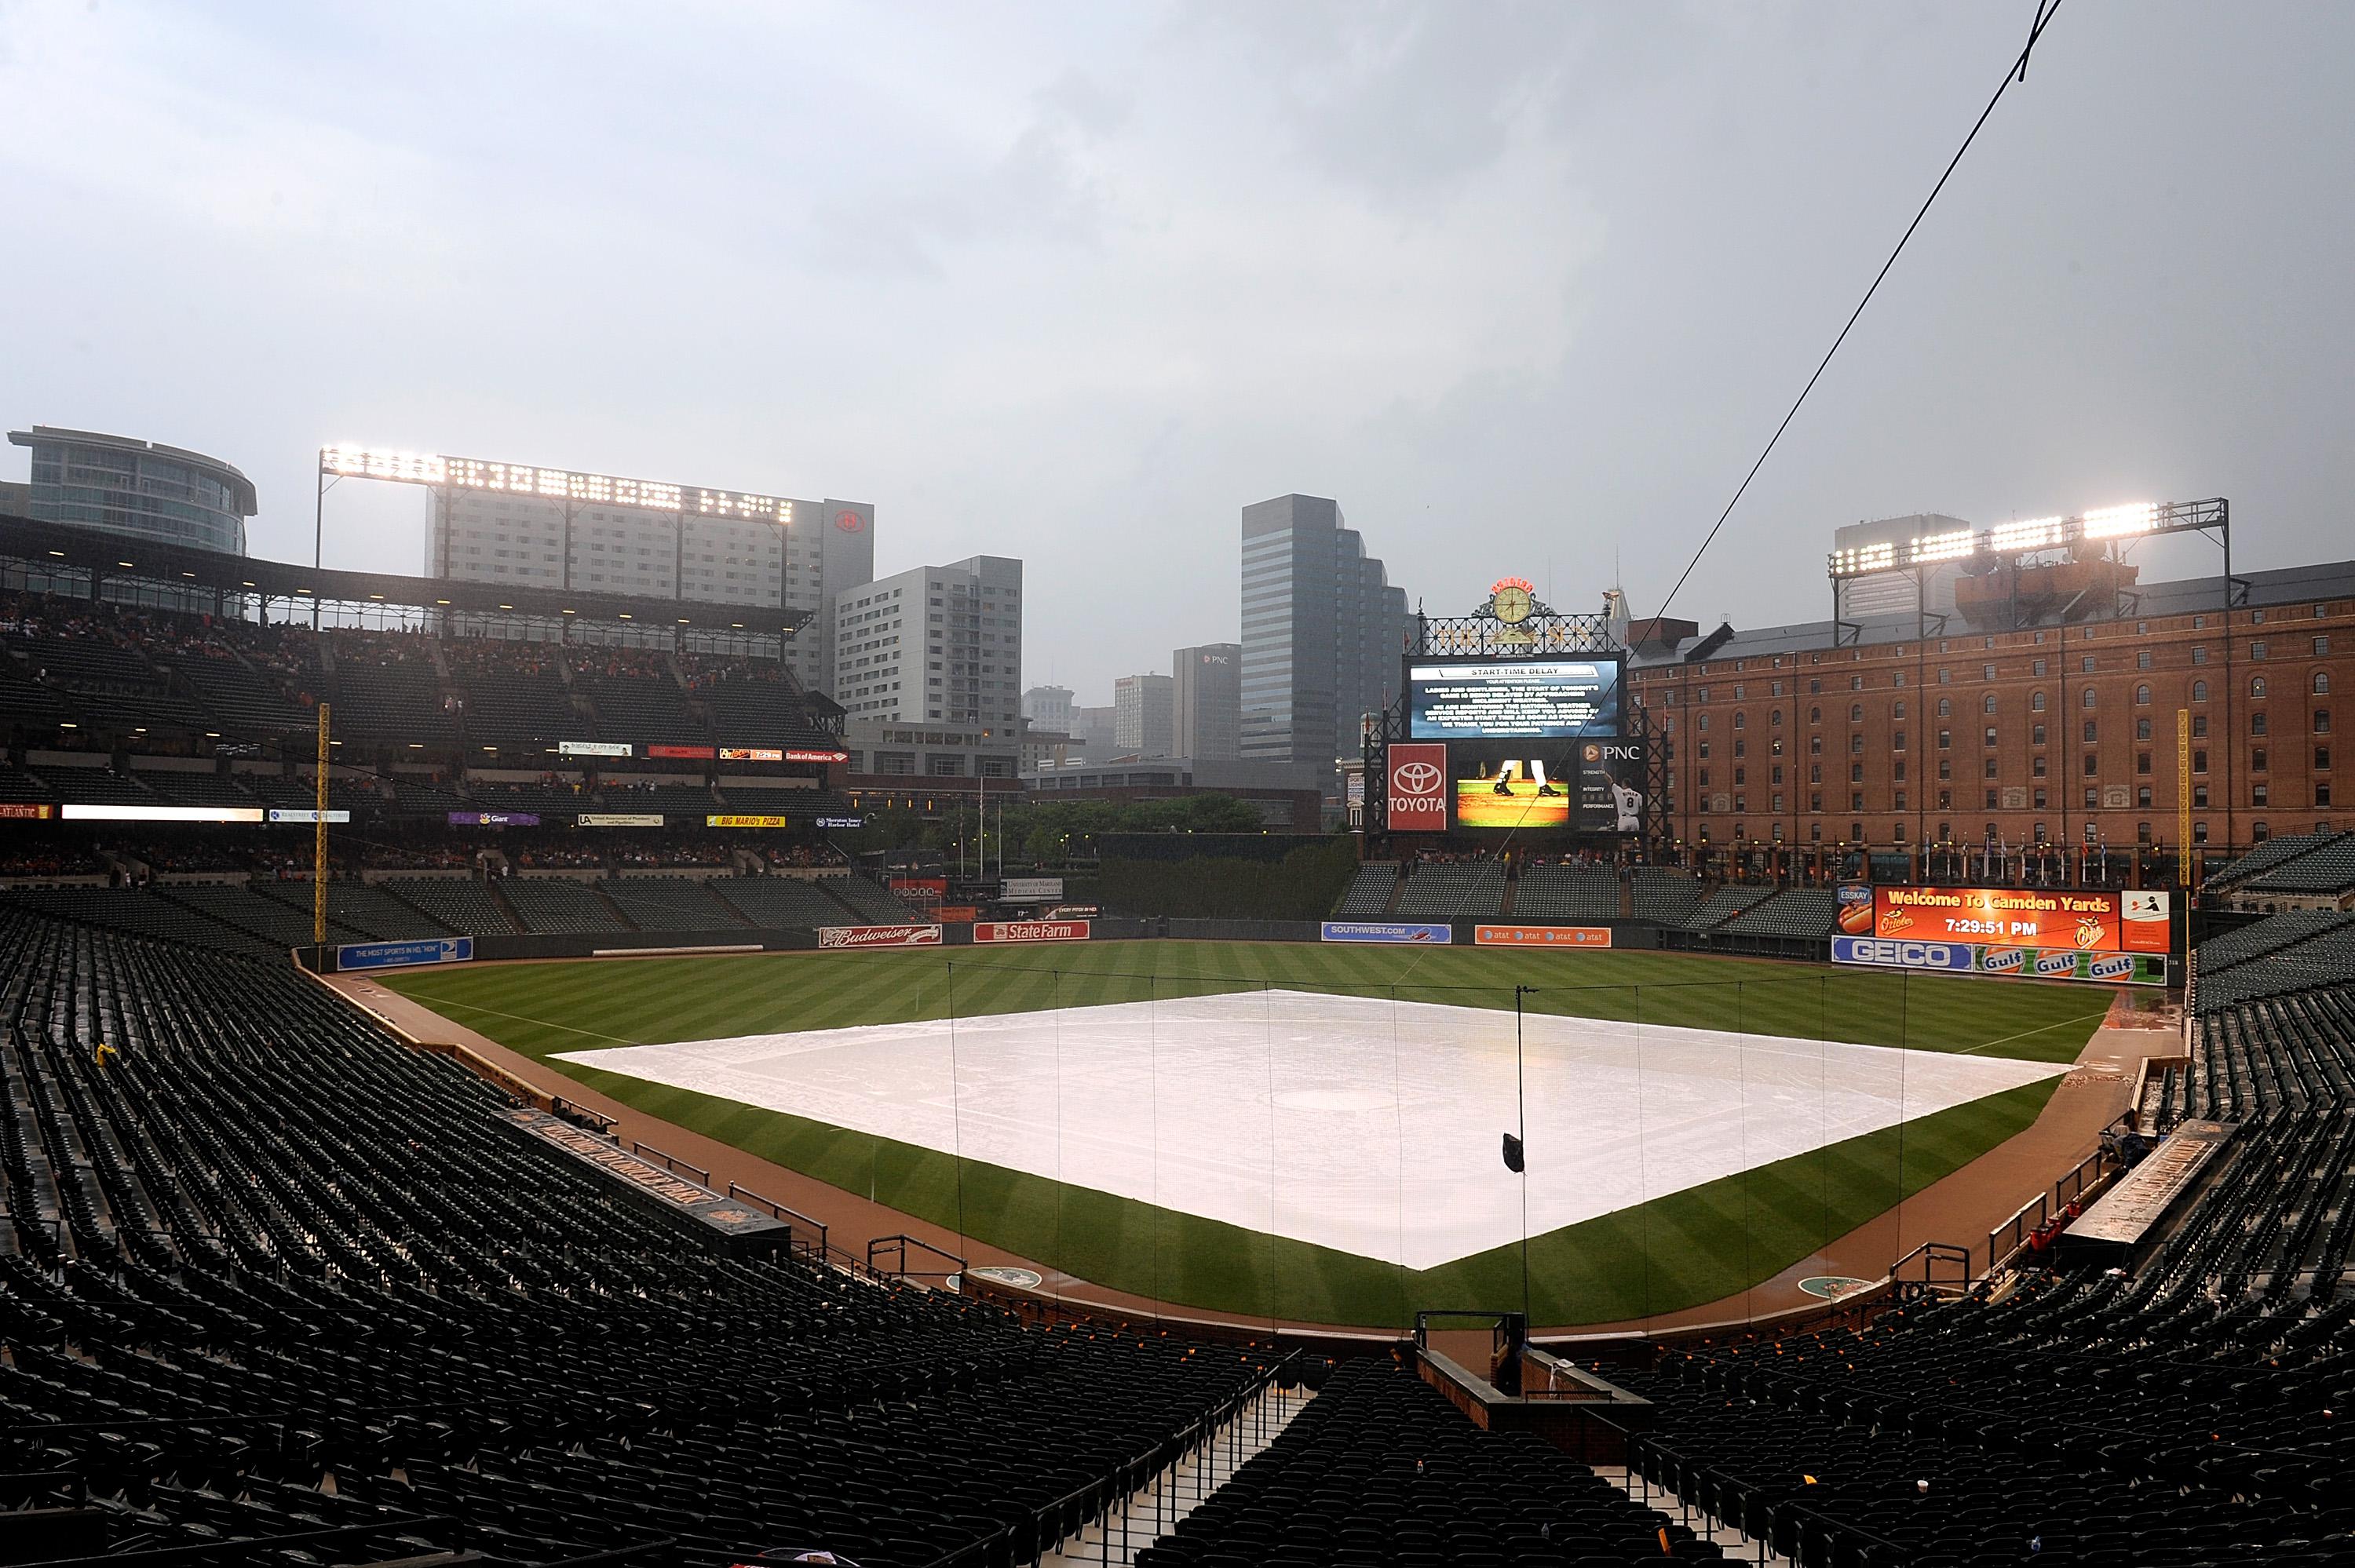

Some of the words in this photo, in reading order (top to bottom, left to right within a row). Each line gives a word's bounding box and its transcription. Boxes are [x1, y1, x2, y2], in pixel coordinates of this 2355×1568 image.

[1435, 629, 1479, 647] THE
[1546, 625, 1592, 645] SUN
[1603, 746, 1640, 760] PNC
[1389, 797, 1446, 812] TOYOTA
[1627, 797, 1634, 808] 8
[580, 816, 592, 825] UA
[762, 817, 780, 826] PIZZA
[1841, 891, 1868, 899] ESSKAY
[1888, 891, 1961, 907] Welcome
[1965, 894, 1984, 909] To
[1989, 895, 2057, 910] Camden
[2061, 897, 2110, 913] Yards
[1331, 925, 1406, 935] SOUTHWEST.COM
[1945, 918, 2005, 935] 7:29:51
[2011, 921, 2038, 936] PM
[833, 926, 912, 946] Budweiser
[356, 950, 367, 958] THE
[367, 948, 383, 957] MOST
[384, 946, 405, 956] SPORTS
[1852, 940, 1951, 967] GEICO
[1985, 952, 2021, 969] Gulf
[2036, 954, 2075, 972] Gulf
[2090, 957, 2133, 976] Gulf
[589, 1150, 625, 1162] TO
[652, 1182, 714, 1204] PARK
